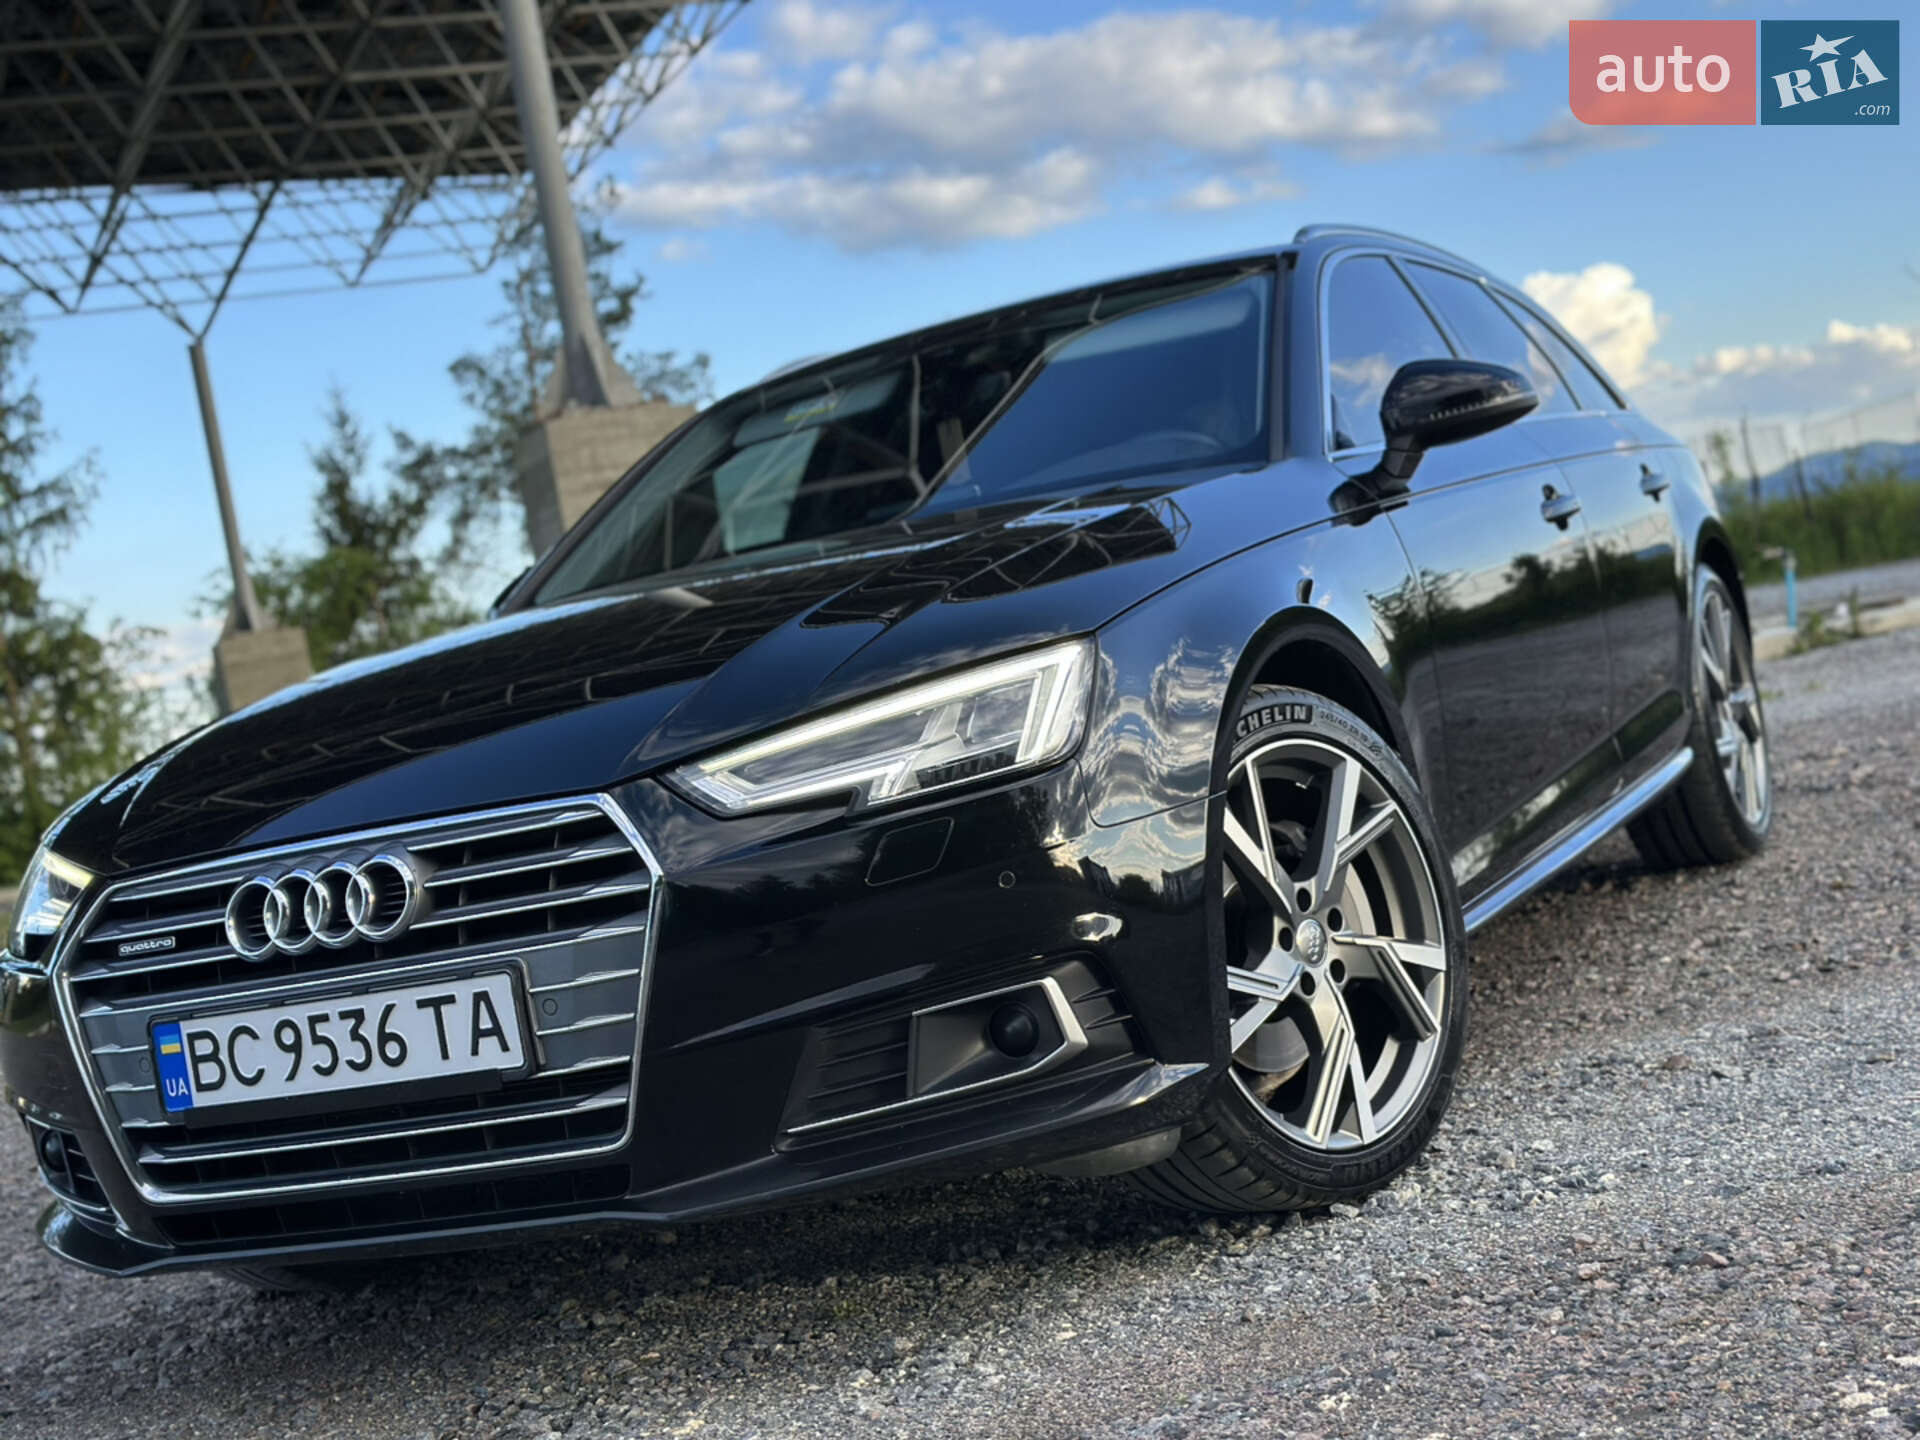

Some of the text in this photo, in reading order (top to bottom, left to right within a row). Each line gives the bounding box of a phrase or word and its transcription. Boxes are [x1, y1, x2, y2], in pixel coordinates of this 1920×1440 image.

[120, 939, 172, 954] quattro
[186, 990, 510, 1092] BC 9536 TA
[166, 1076, 188, 1097] UA
